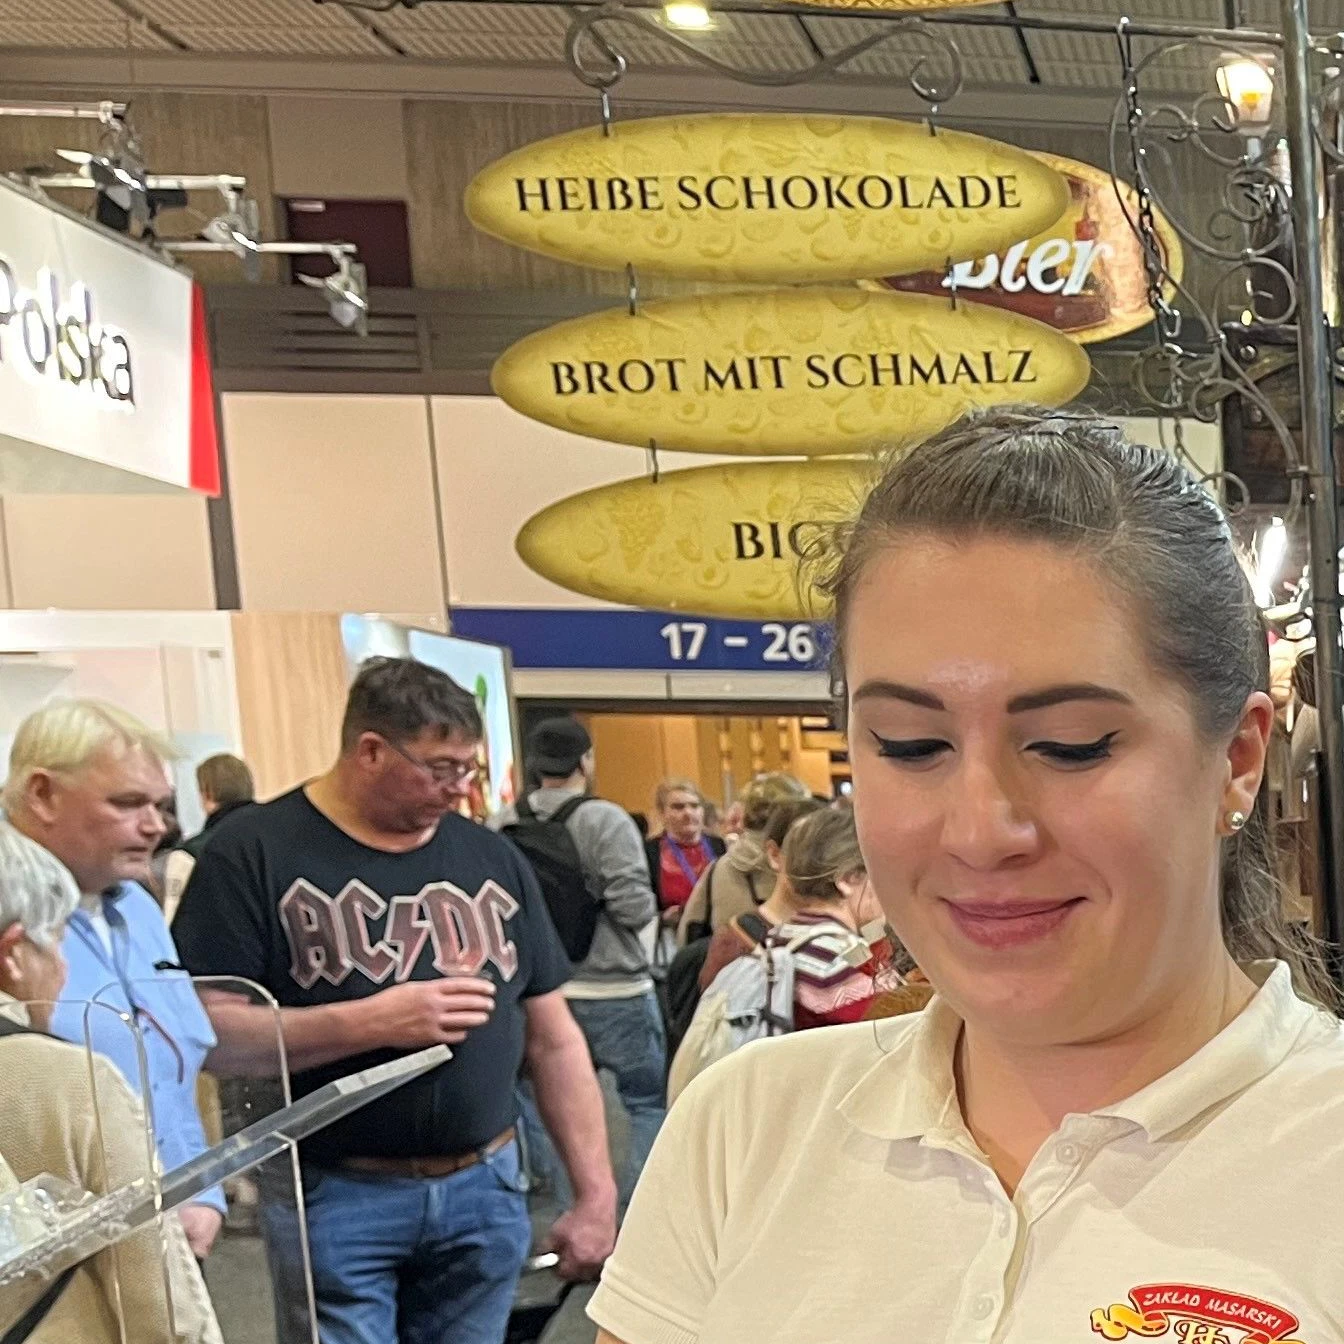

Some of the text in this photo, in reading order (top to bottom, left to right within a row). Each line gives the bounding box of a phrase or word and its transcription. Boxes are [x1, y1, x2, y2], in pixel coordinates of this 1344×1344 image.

[678, 174, 1022, 211] SCHOKOLADE
[549, 349, 1038, 395] BROT MIT SCHMALZ
[661, 622, 708, 660] 17
[761, 624, 815, 662] 26
[1204, 1298, 1282, 1330] MASARSKI
